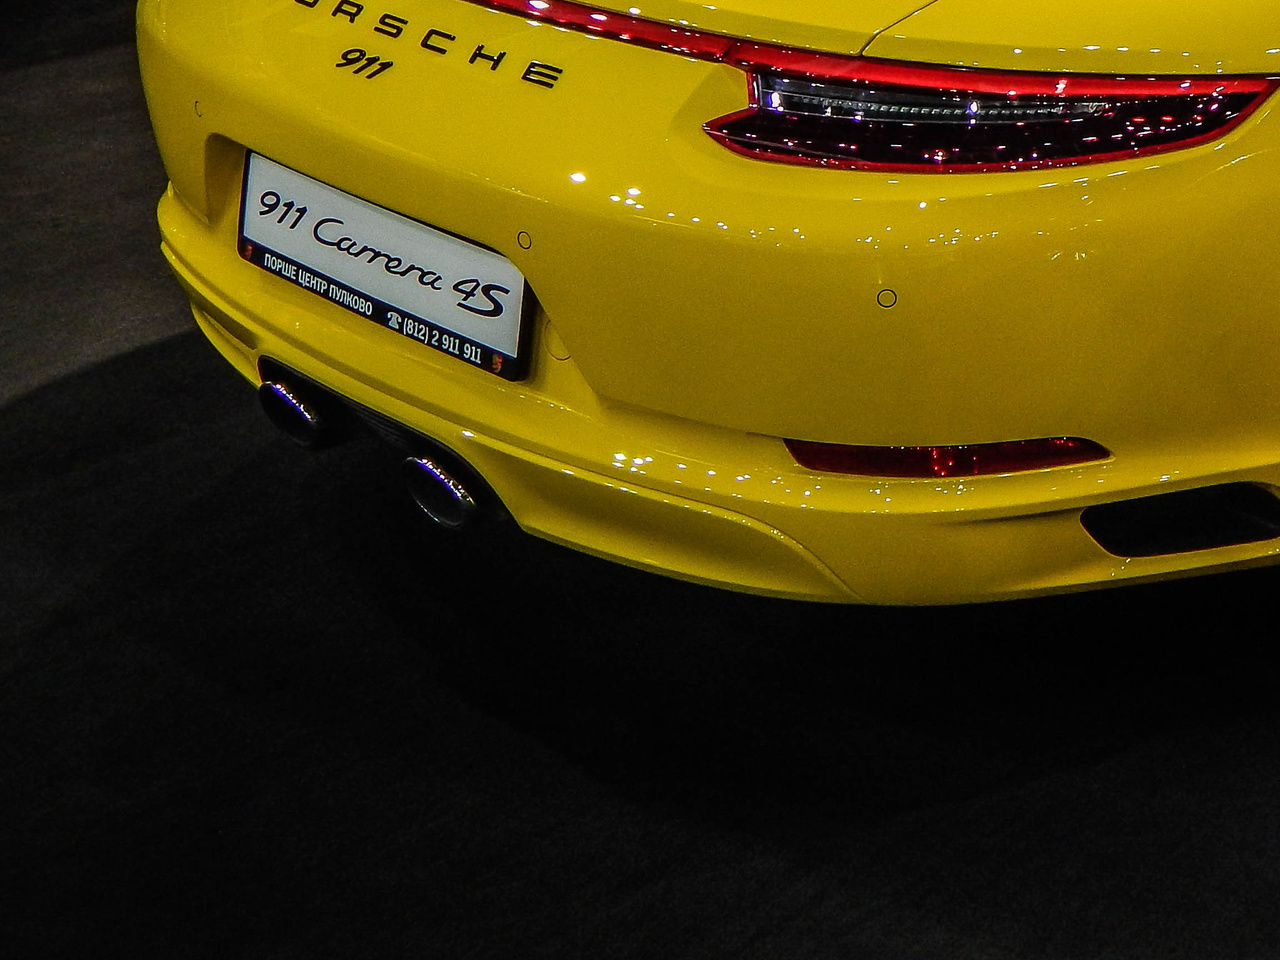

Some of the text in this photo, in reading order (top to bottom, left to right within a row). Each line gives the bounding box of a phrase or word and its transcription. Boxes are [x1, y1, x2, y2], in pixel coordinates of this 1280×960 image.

[335, 47, 394, 80] 911
[258, 190, 511, 319] 911 Carrera 4S
[263, 252, 373, 316] ПОРШЕ ЦЕНТР ПУЛКОВО
[402, 316, 482, 365] (812) 2 911 911
